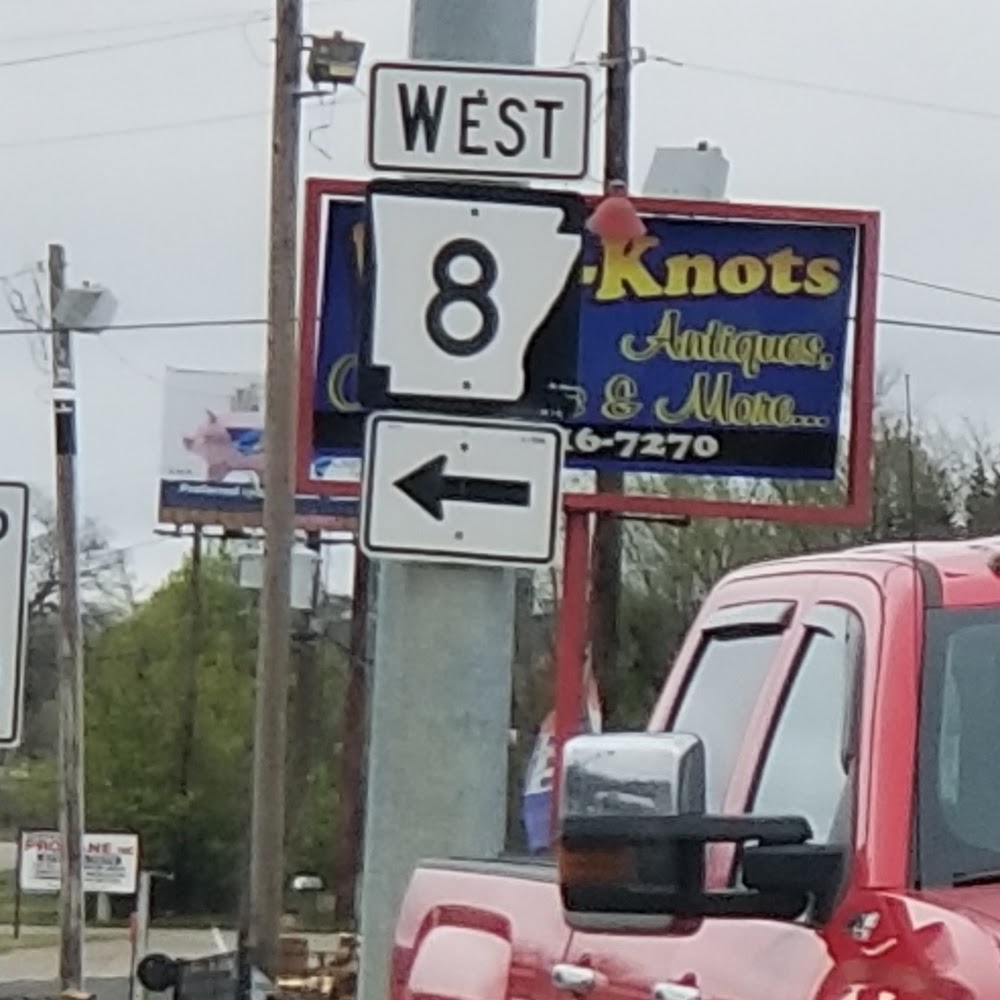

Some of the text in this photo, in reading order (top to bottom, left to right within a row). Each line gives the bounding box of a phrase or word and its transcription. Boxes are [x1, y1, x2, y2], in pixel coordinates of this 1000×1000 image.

[397, 83, 564, 159] WEST
[425, 237, 499, 357] 8
[620, 309, 834, 378] Antiques,
[601, 374, 643, 420] &
